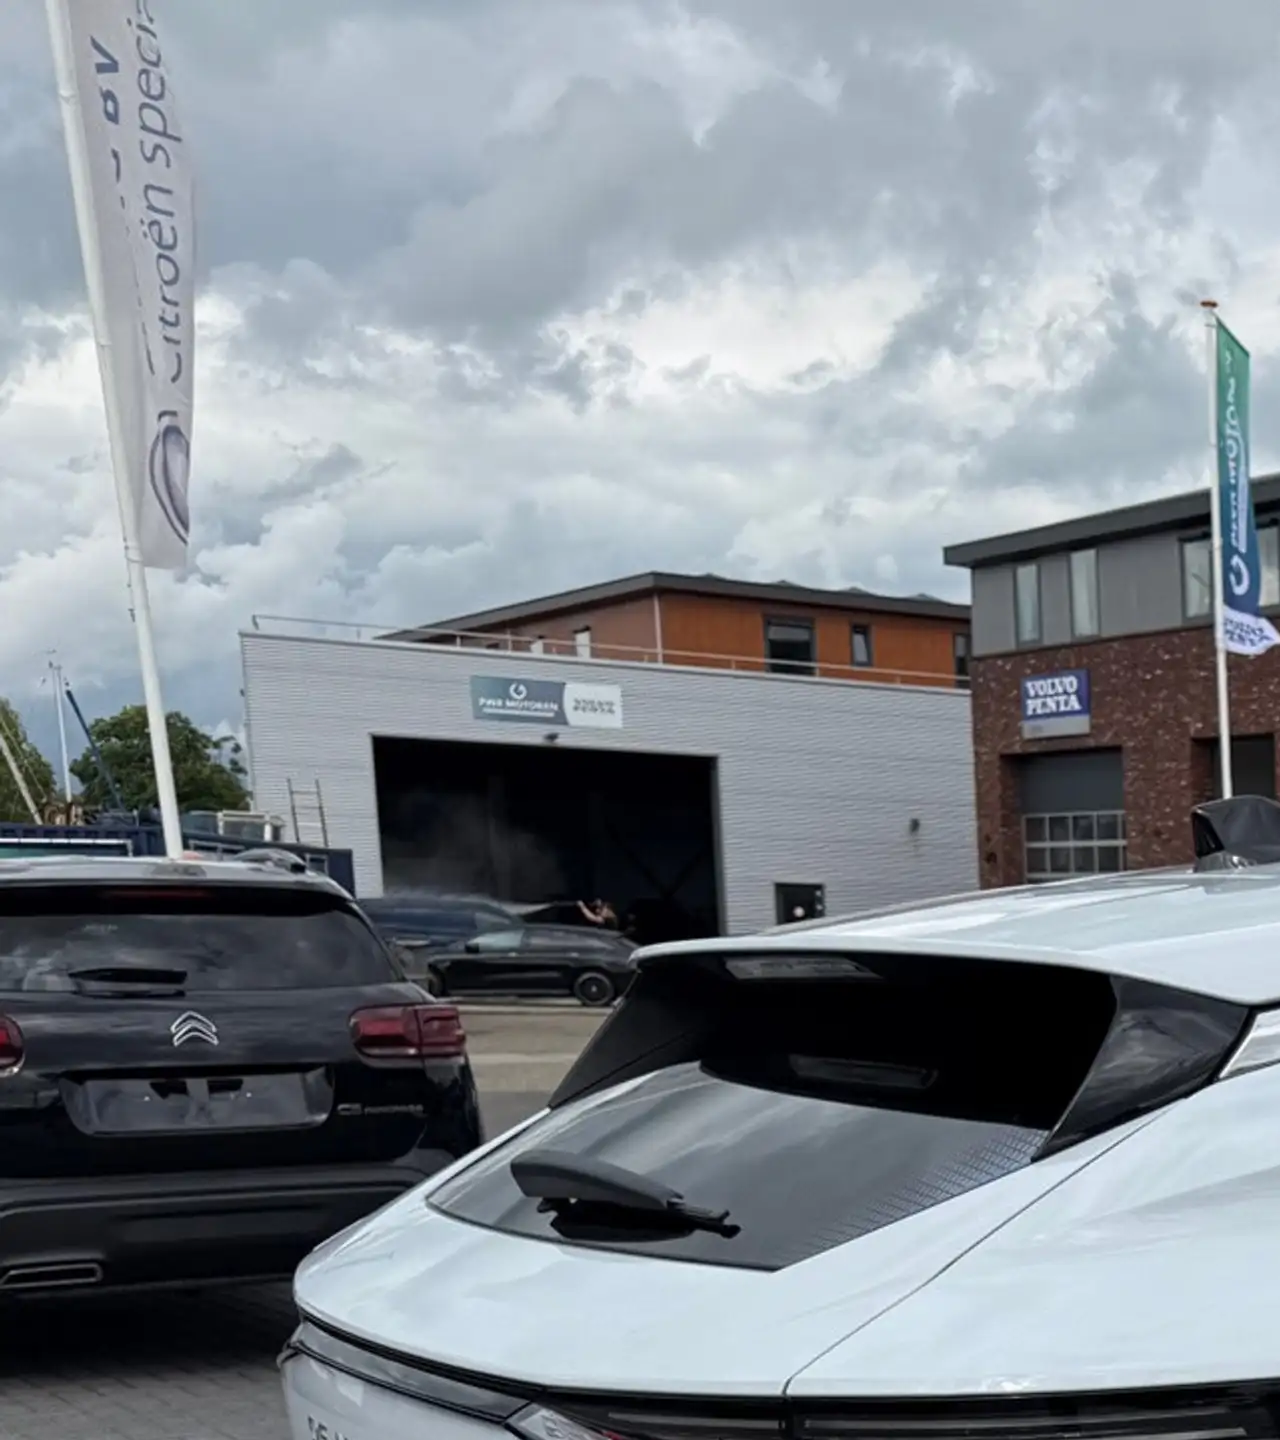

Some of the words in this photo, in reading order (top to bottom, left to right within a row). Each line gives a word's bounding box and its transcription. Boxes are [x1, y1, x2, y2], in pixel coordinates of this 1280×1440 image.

[127, 0, 182, 169] speci
[1025, 675, 1078, 697] VOLVO
[1026, 694, 1082, 716] PENTA
